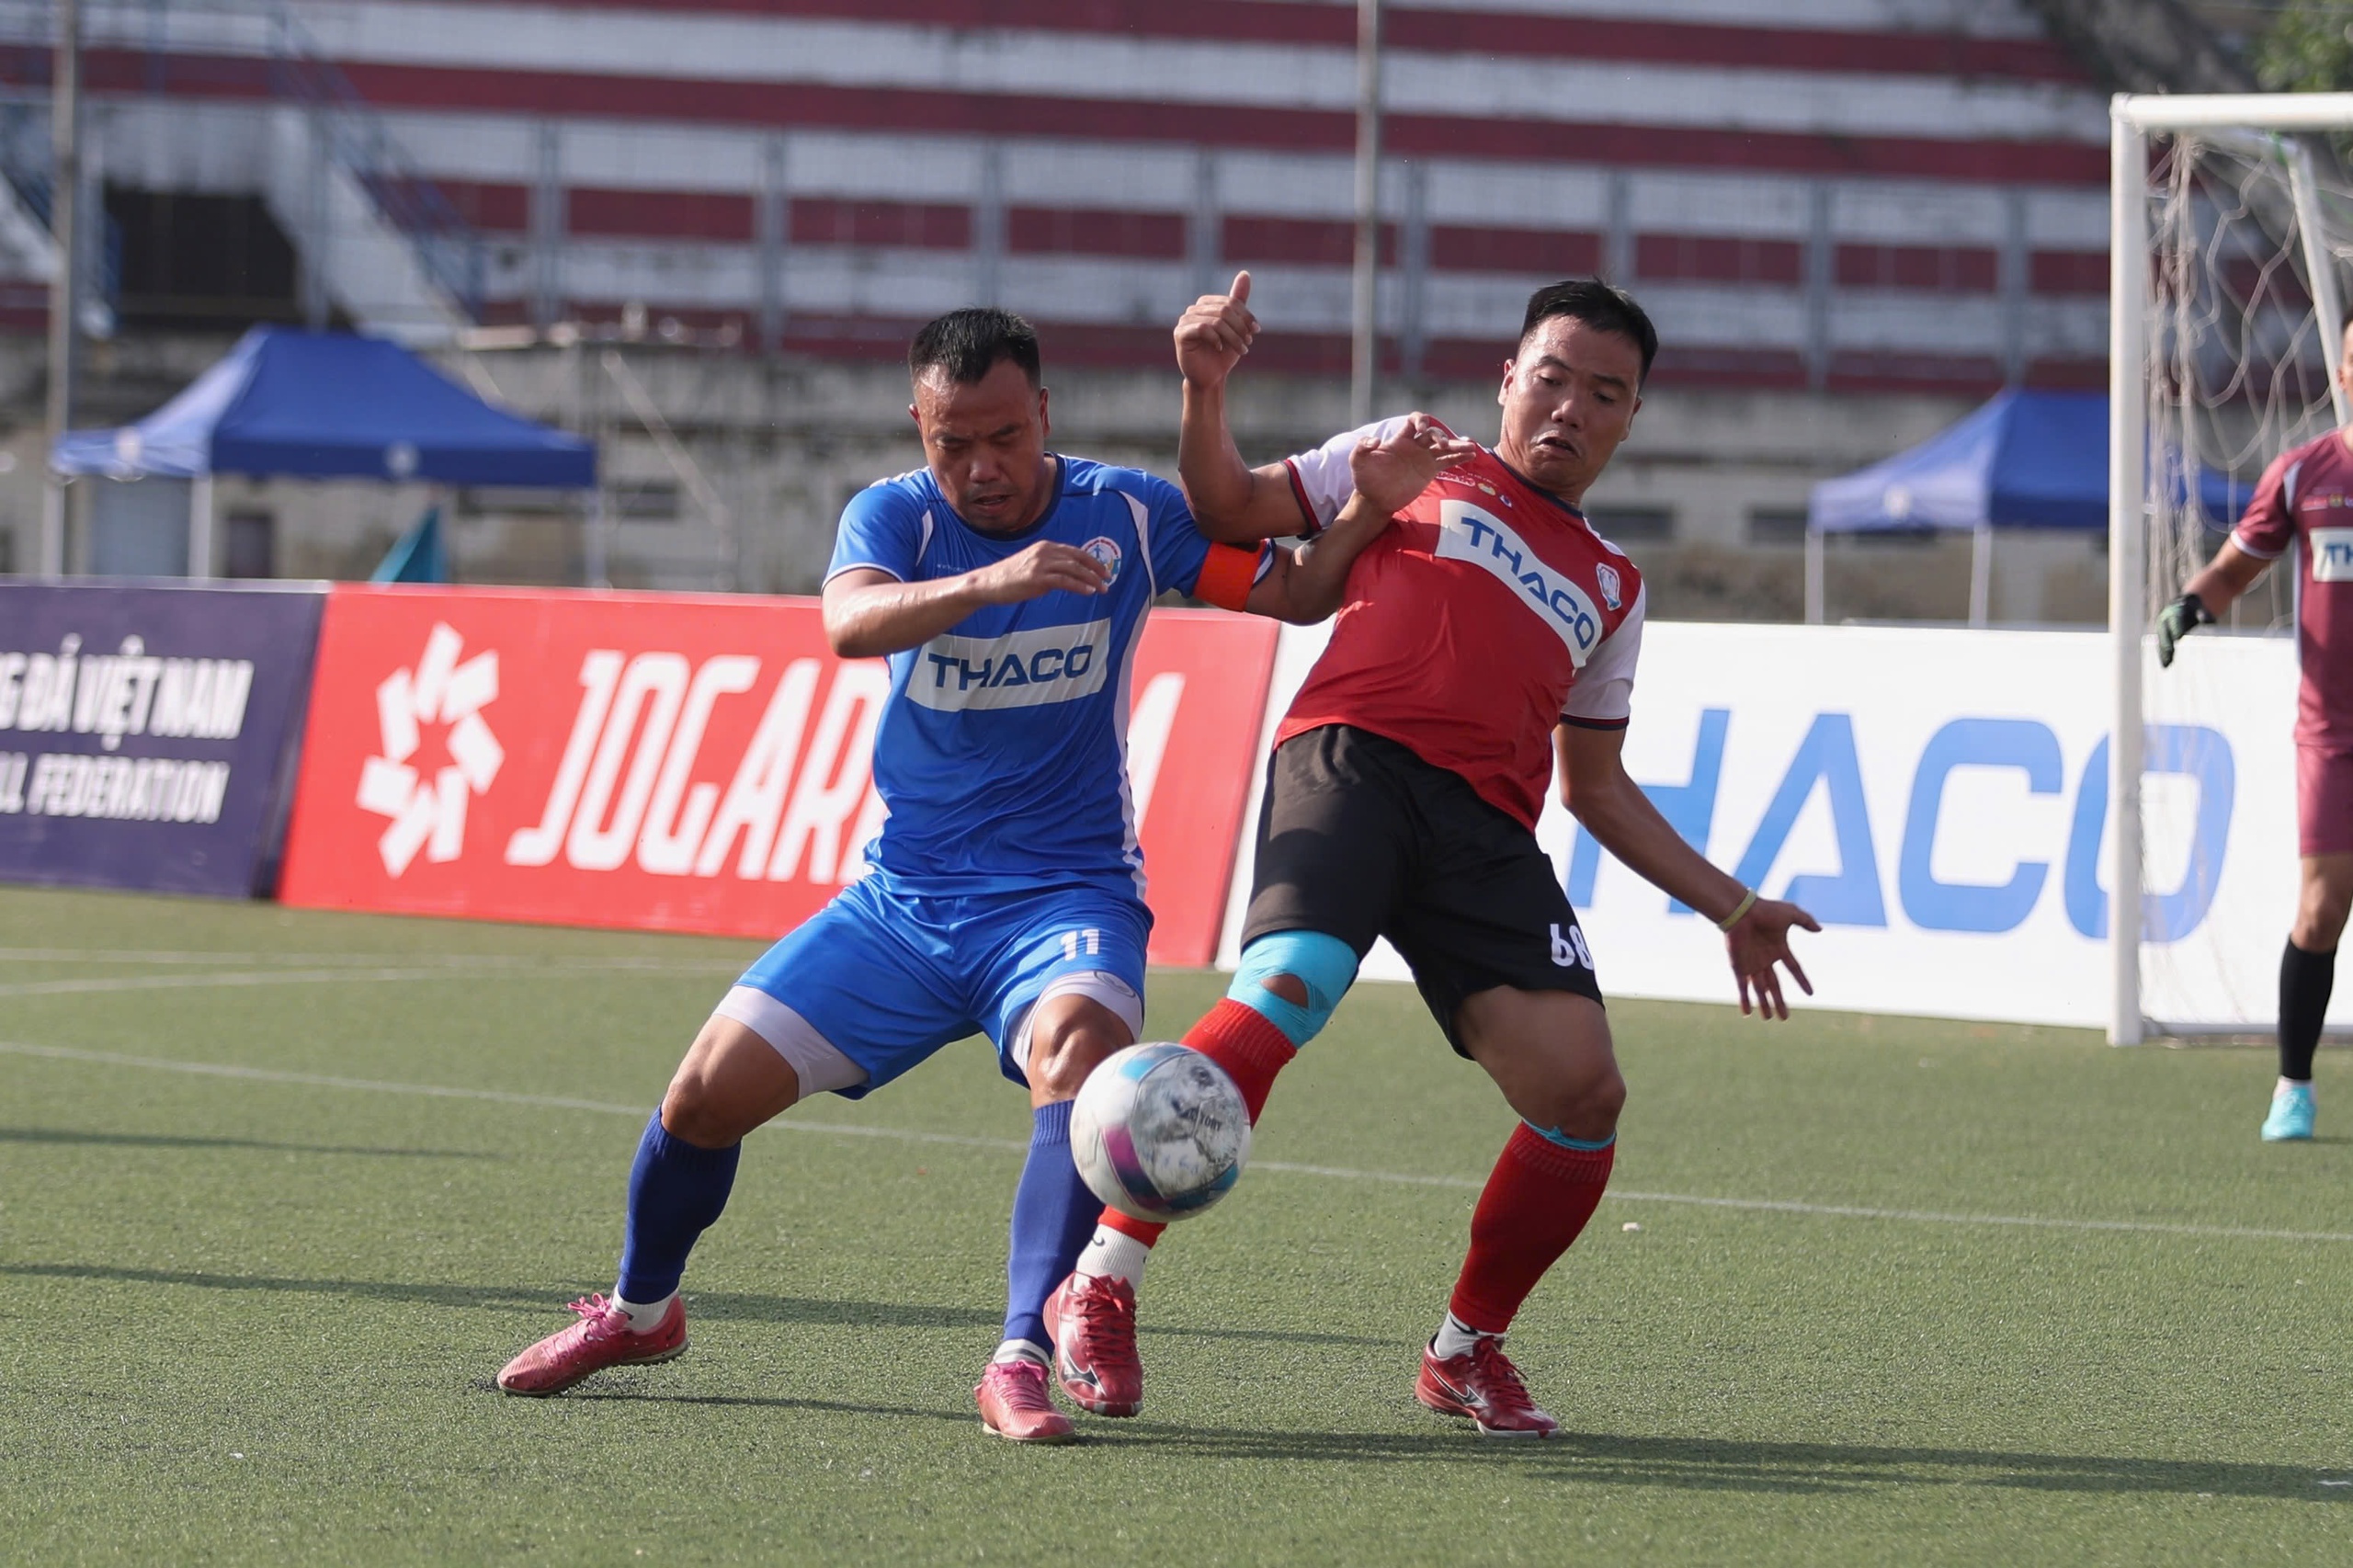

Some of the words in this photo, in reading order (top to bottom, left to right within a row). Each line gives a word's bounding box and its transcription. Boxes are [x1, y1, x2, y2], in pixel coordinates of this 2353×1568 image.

[1461, 517, 1596, 650] THACO
[73, 634, 163, 752] VIỆT
[149, 656, 255, 740] NAM
[928, 645, 1093, 690] THACO
[26, 753, 230, 824] FEDERATION
[504, 649, 1188, 887] JOGAR
[1565, 708, 2235, 942] HACO
[1061, 928, 1099, 961] 11
[1550, 923, 1595, 971] 68
